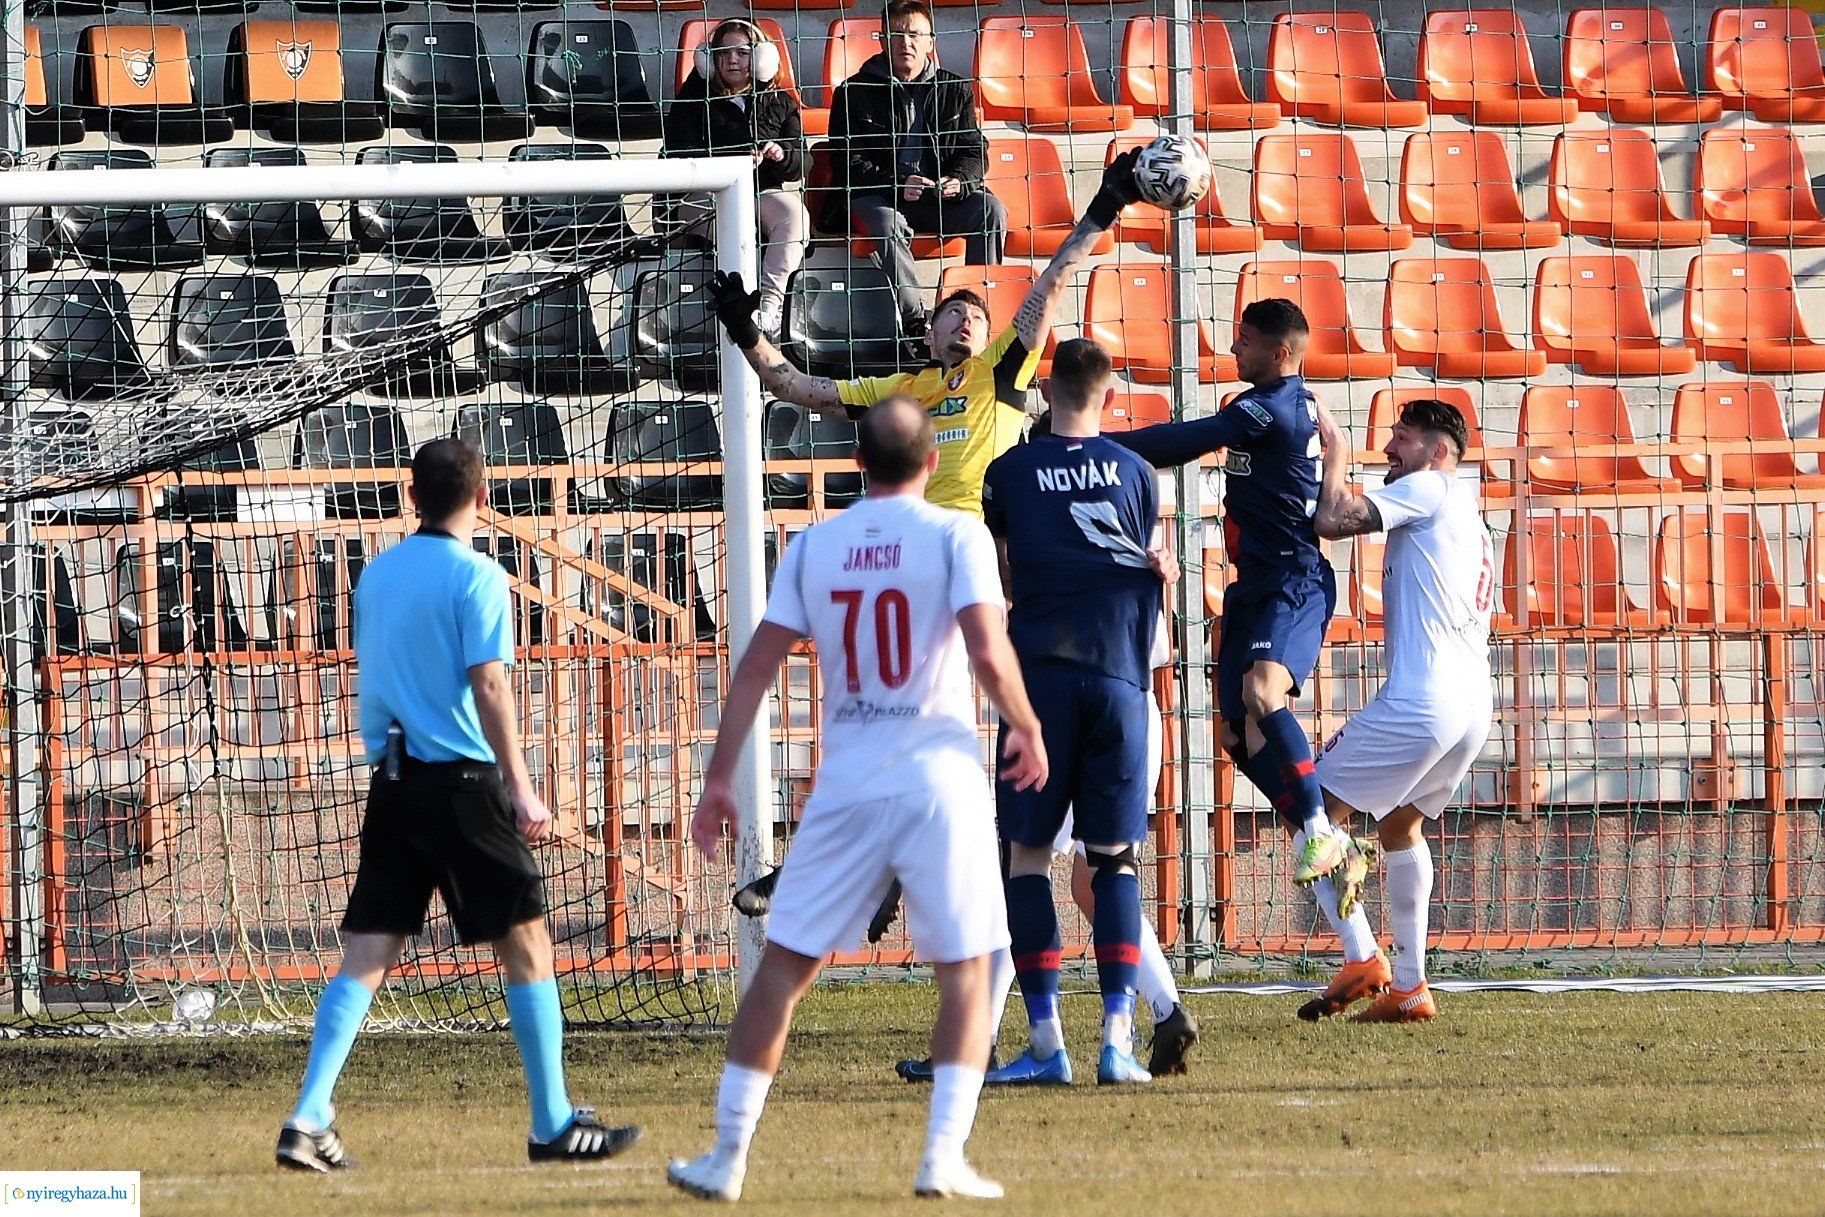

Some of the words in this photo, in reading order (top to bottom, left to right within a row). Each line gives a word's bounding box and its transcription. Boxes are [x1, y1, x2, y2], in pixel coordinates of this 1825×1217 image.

[1036, 458, 1122, 492] NOVÁK
[843, 537, 902, 572] JANCSÓ
[830, 588, 912, 693] 70
[1251, 641, 1272, 650] JAKO
